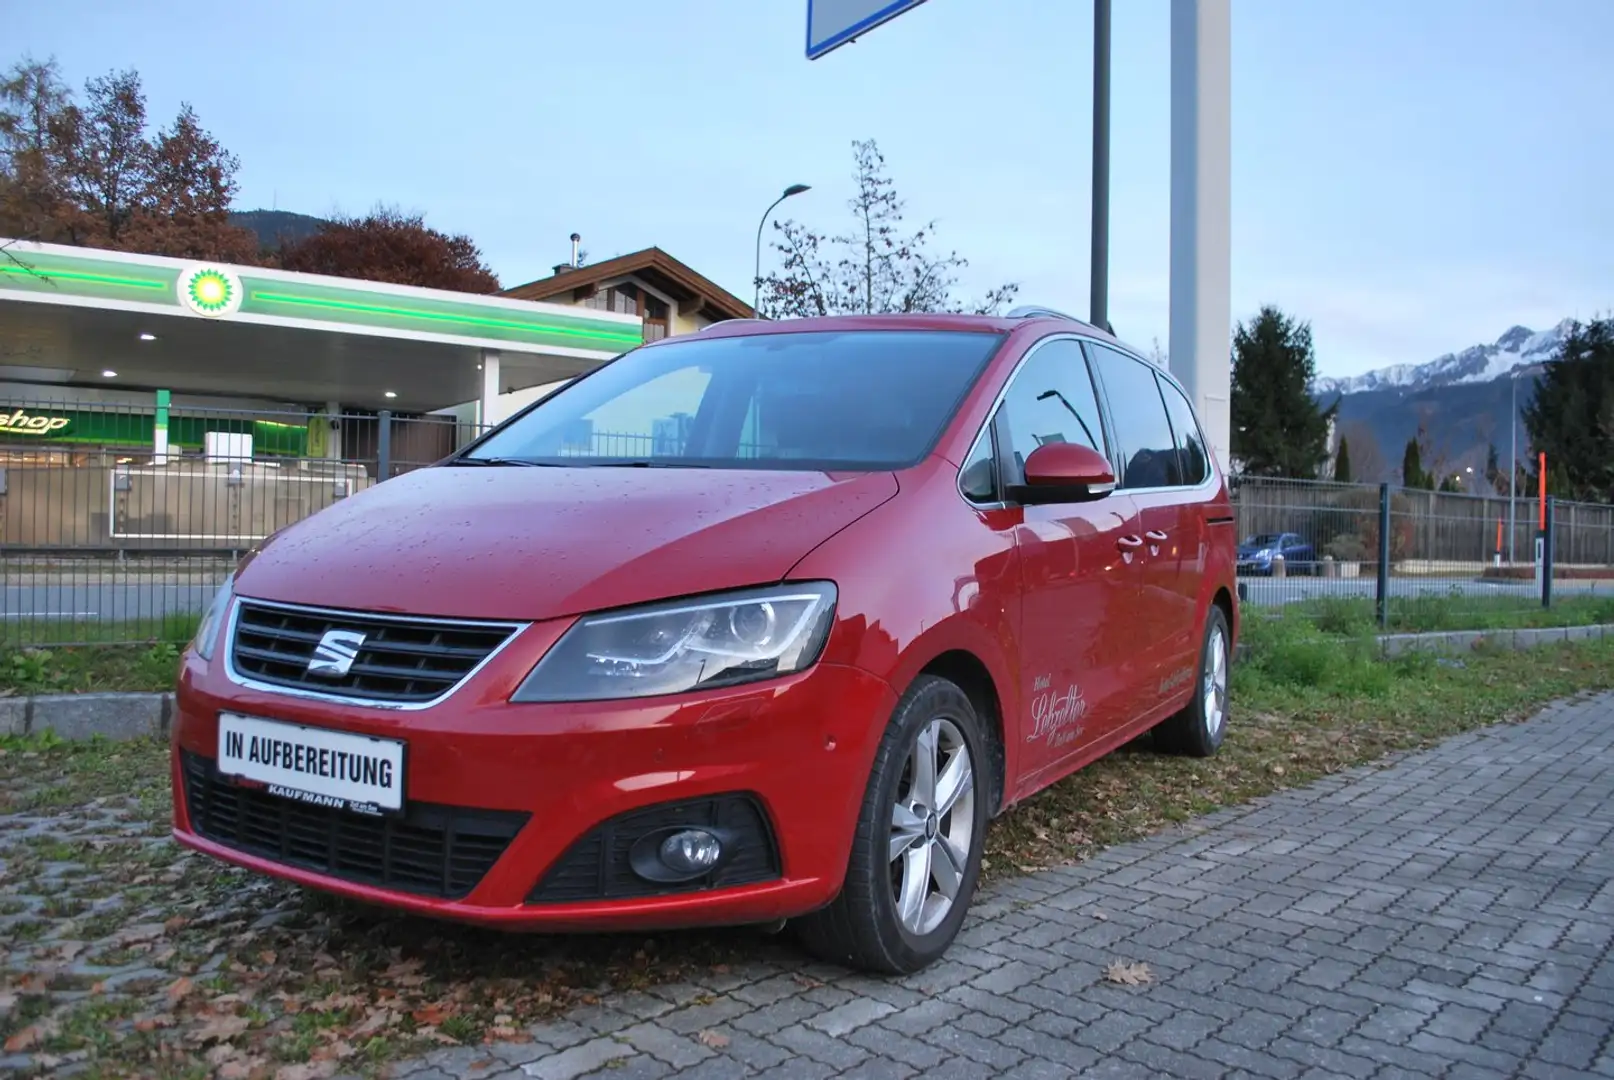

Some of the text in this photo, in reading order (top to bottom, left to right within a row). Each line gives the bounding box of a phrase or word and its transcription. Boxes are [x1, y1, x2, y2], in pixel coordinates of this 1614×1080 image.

[226, 730, 392, 789] IN AUFBEREITUNG
[268, 784, 345, 809] KAUFMANN
